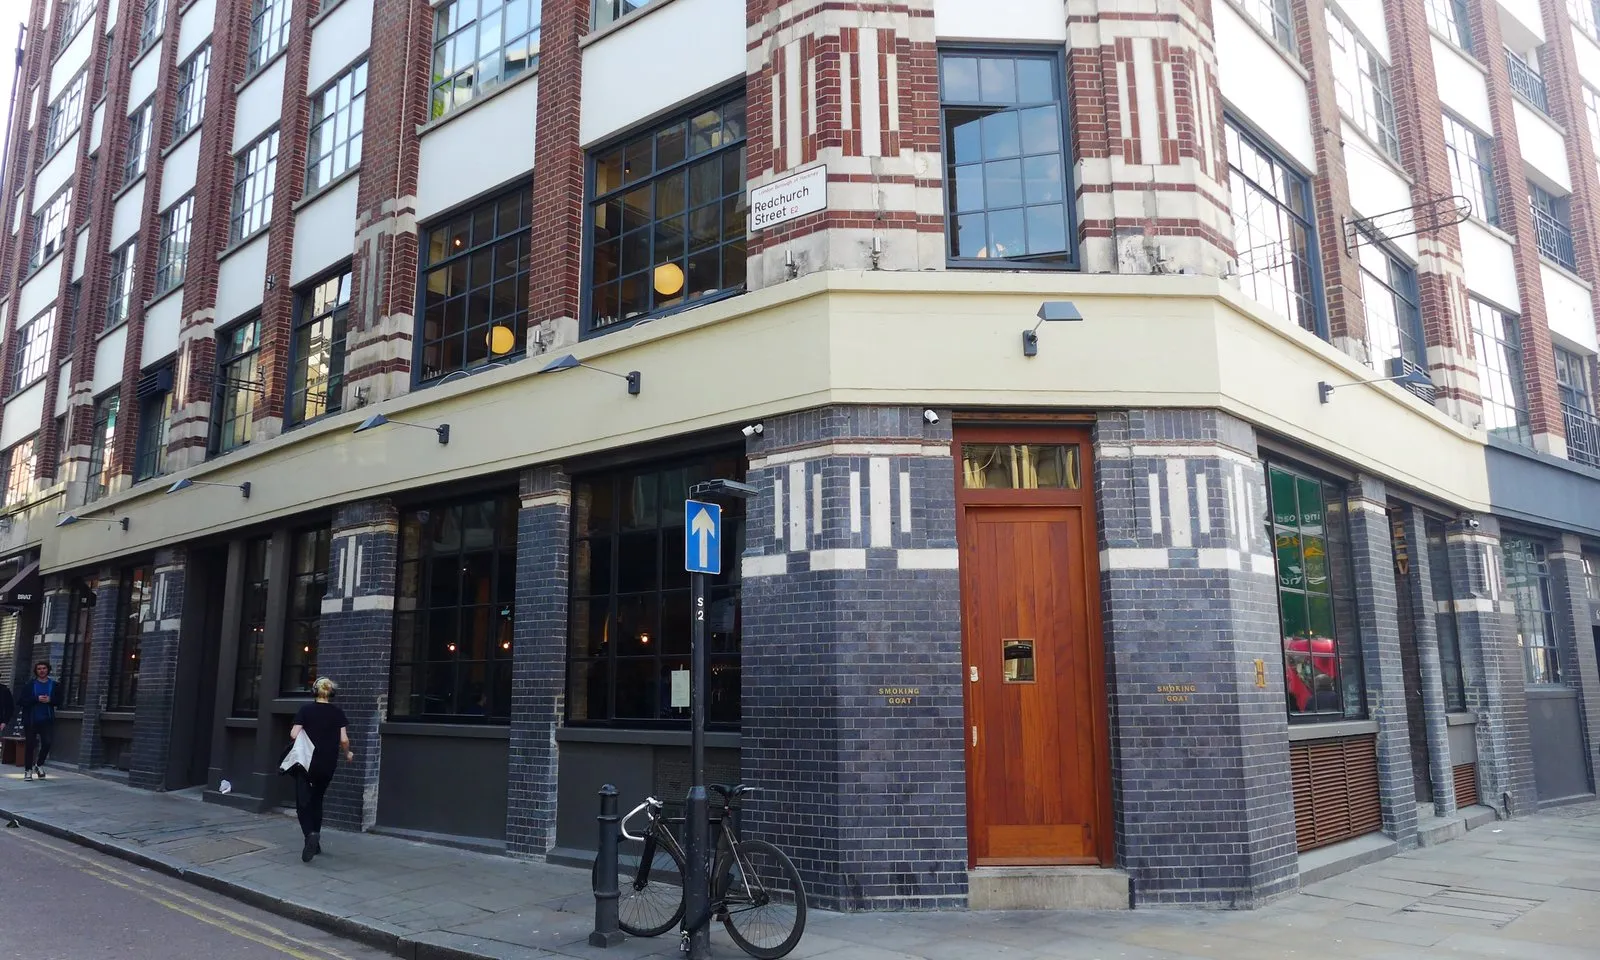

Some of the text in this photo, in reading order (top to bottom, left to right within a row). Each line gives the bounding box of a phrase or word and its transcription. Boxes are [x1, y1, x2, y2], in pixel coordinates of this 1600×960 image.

[754, 186, 809, 213] Redchurch
[755, 206, 799, 225] Street E2
